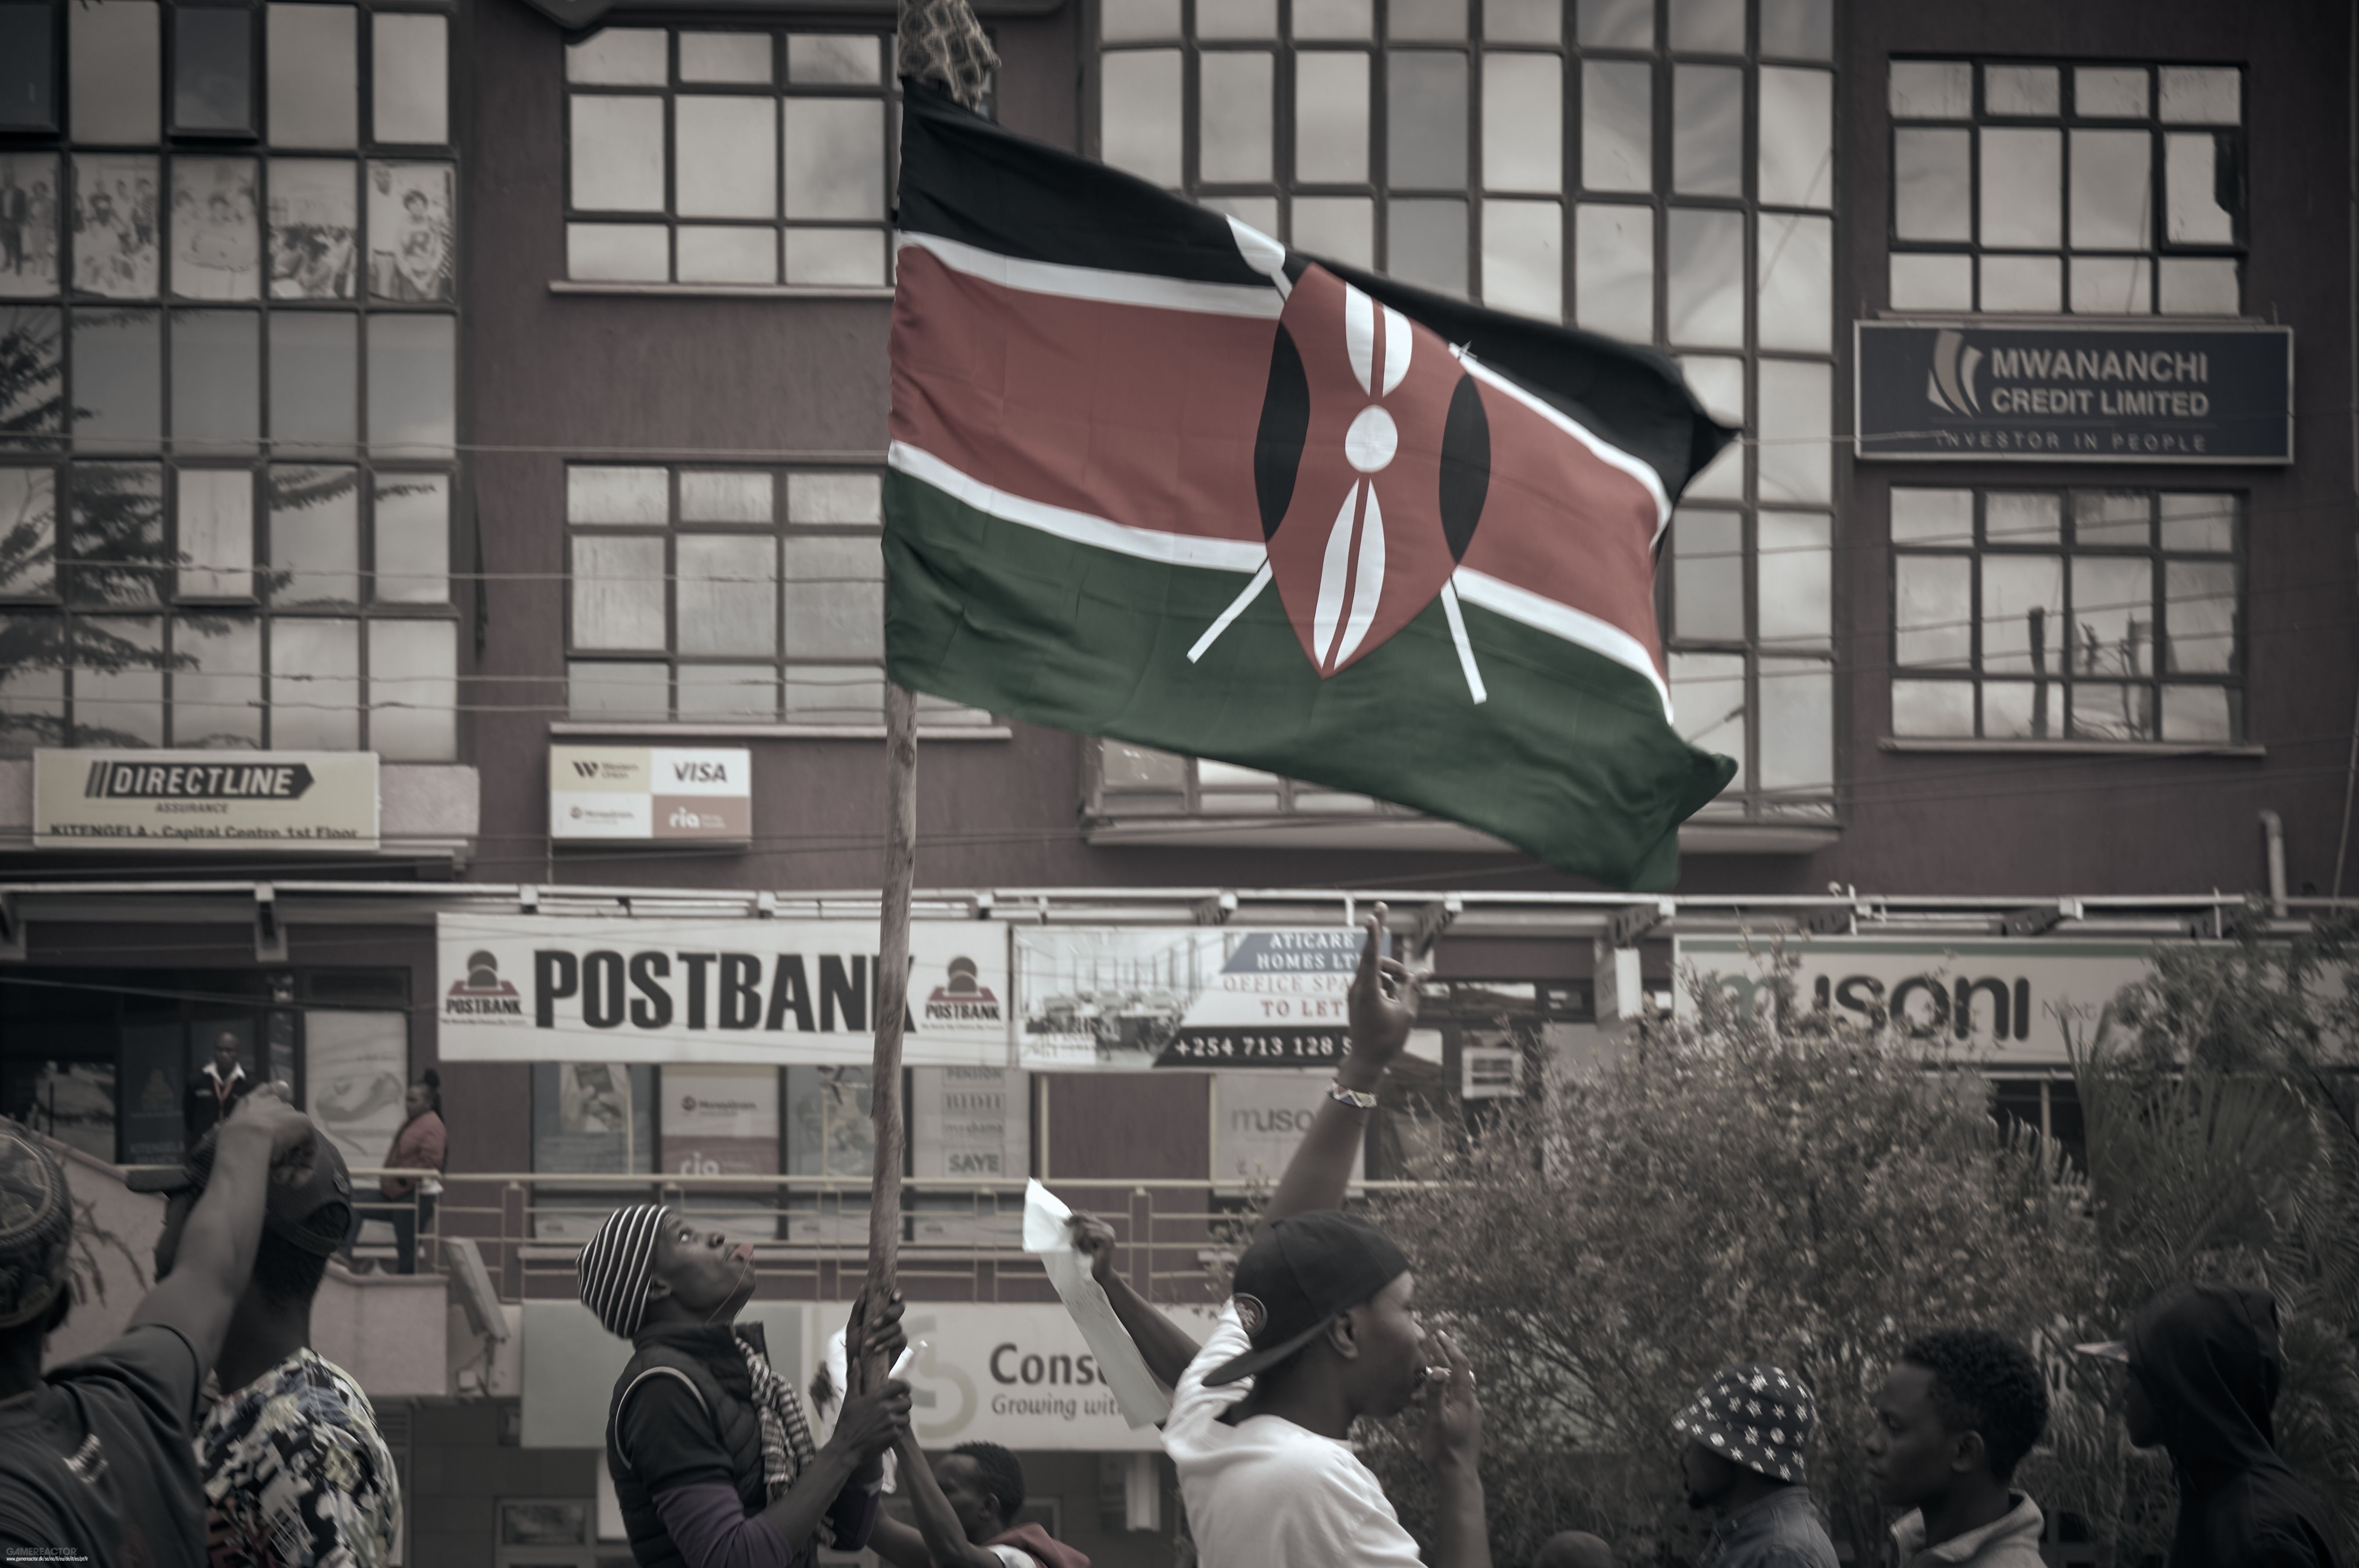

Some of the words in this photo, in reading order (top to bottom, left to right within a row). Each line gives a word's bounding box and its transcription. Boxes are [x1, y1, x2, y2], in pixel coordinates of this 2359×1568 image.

[1991, 349, 2209, 383] MWANANCHI
[1991, 388, 2094, 414] CREDIT
[2102, 391, 2210, 417] LIMITED
[1934, 431, 2060, 450] INVESTOR
[2074, 433, 2099, 451] IN
[2112, 434, 2208, 453] PEOPLE
[112, 766, 294, 796] DIRECTLINE
[674, 762, 728, 783] VISA
[156, 802, 229, 813] ASSURANCE
[50, 823, 147, 837] KITENGELA
[162, 824, 219, 840] Capital
[1269, 934, 1356, 949] ATICARE
[1256, 952, 1326, 970] HOMES
[1223, 975, 1303, 992] OFFICE
[1312, 975, 1350, 993] SPA
[446, 998, 522, 1015] POSTBANK
[925, 1004, 1000, 1020] POSTBANK
[1260, 1000, 1290, 1017] TO
[1174, 1037, 1234, 1056] +254
[1244, 1037, 1285, 1056] 713
[1294, 1037, 1333, 1056] 128
[1231, 1108, 1315, 1133] muso
[990, 1343, 1107, 1385] Cons
[992, 1393, 1078, 1421] Growing
[1084, 1394, 1121, 1415] wit
